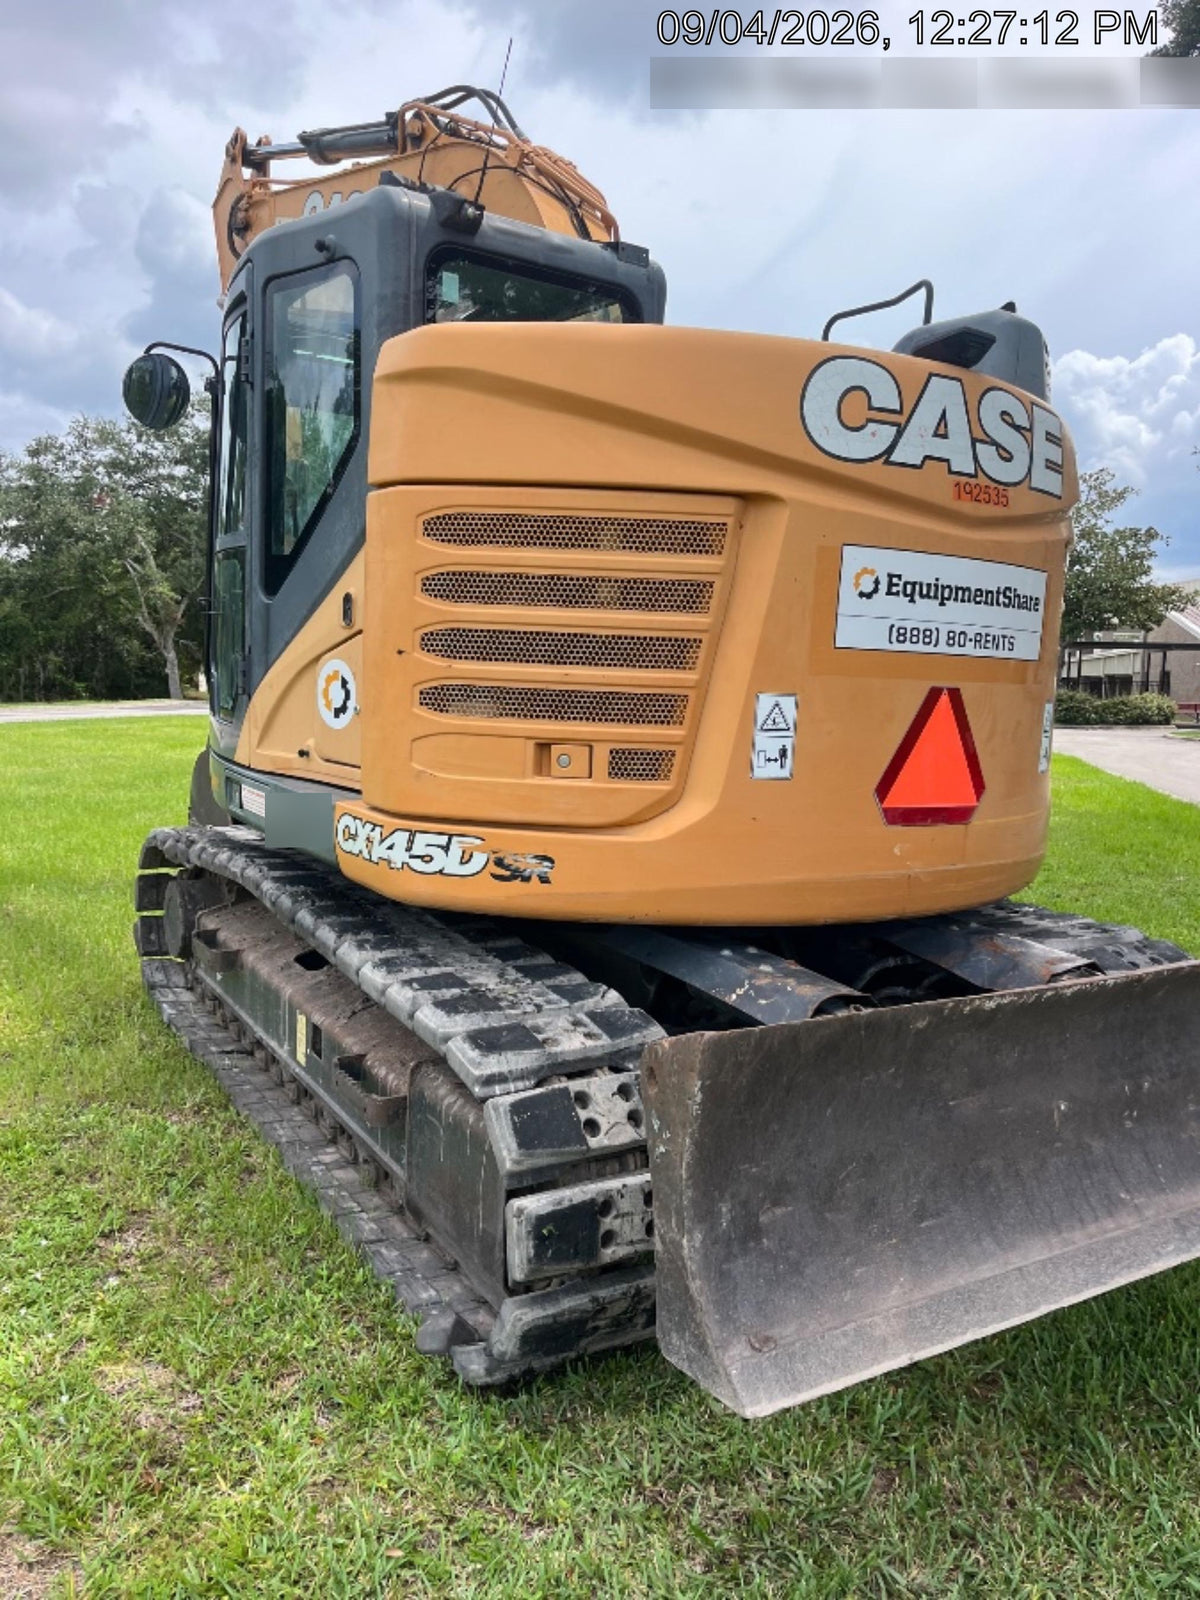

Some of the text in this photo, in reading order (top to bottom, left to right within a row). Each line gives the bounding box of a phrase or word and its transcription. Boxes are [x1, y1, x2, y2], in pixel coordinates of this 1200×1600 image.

[799, 355, 1063, 500] CASE
[953, 482, 1010, 507] 192535
[885, 572, 1040, 612] EquipmentShare
[888, 624, 1016, 651] (888) 80-RENTS
[336, 812, 489, 877] CX145D
